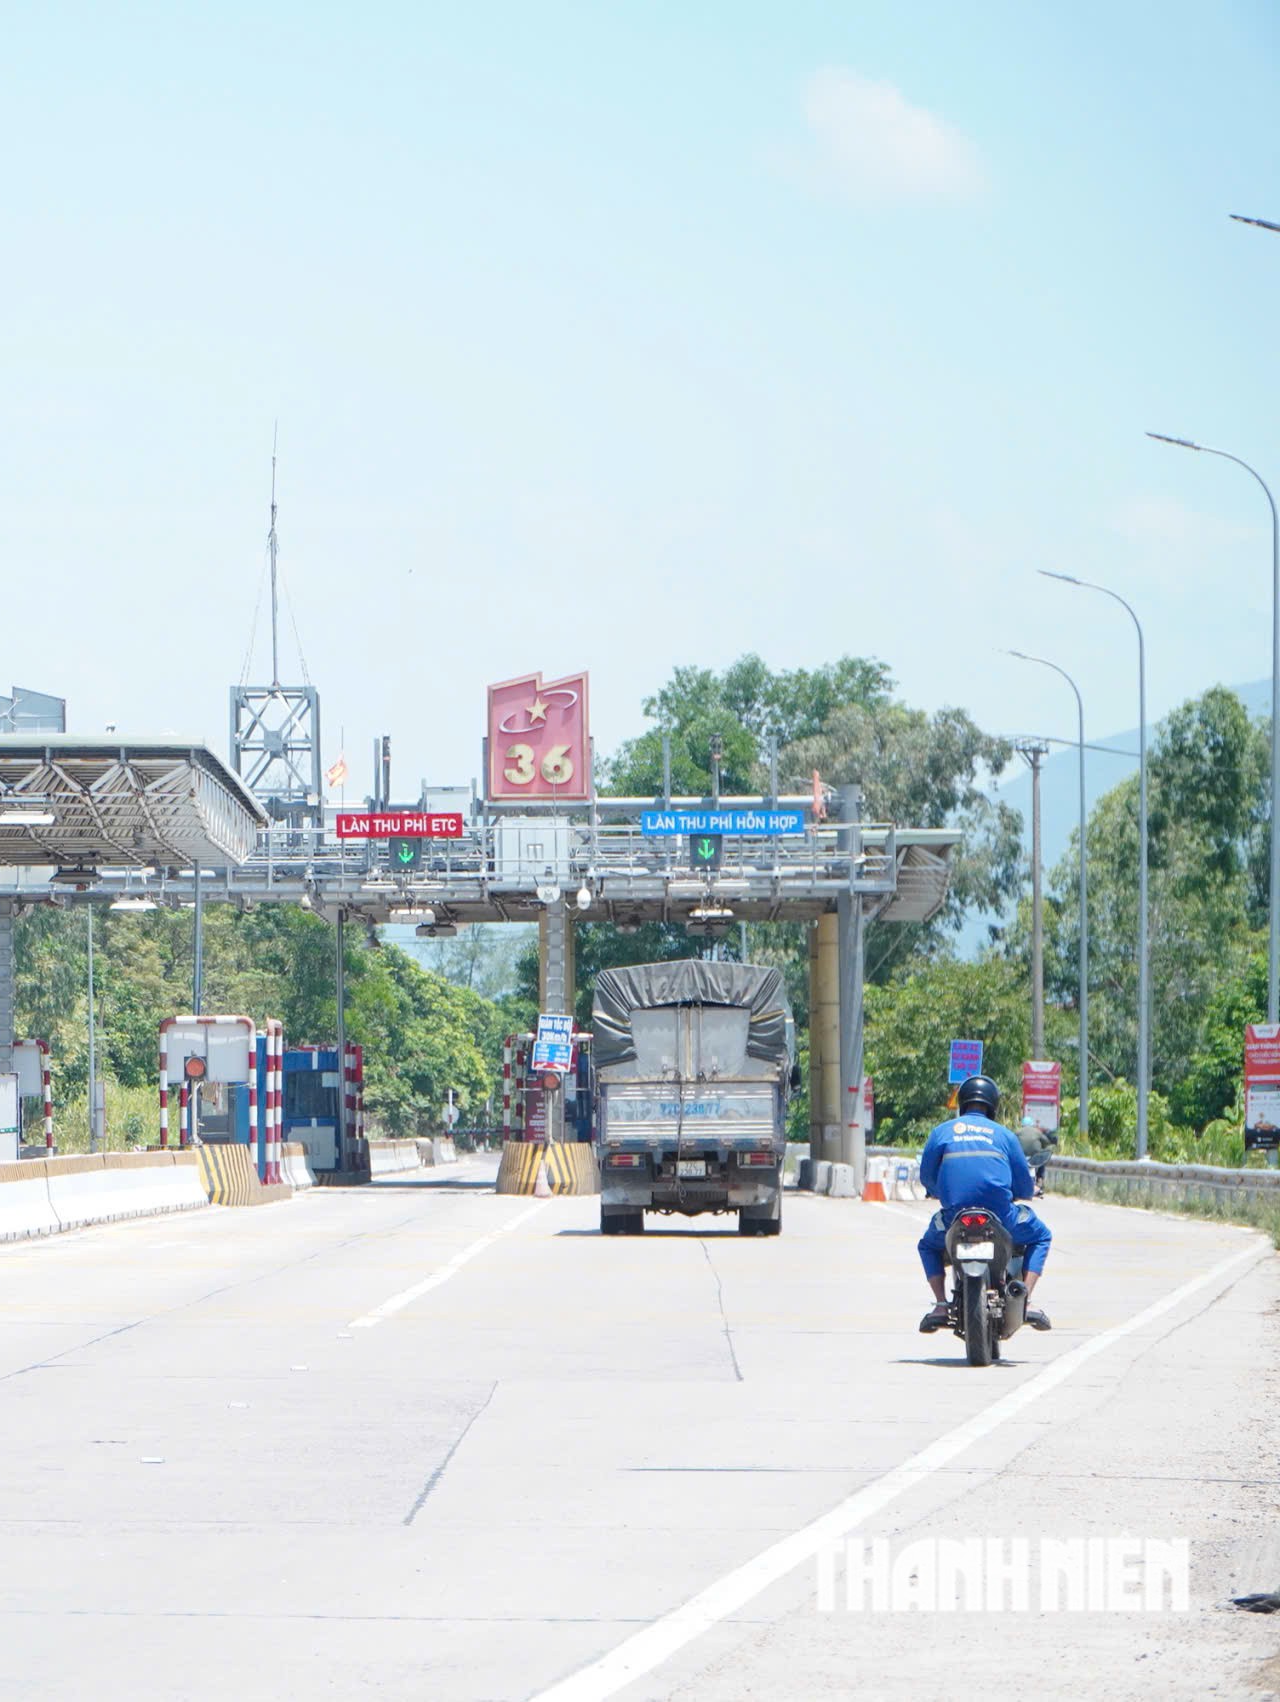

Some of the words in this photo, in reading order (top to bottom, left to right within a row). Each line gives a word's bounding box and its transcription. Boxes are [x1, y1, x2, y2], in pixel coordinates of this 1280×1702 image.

[504, 743, 574, 785] 36
[341, 816, 370, 833] LÀN
[372, 819, 401, 833] THU
[404, 815, 428, 833] PHÍ
[431, 818, 457, 832] ETC
[647, 812, 676, 830] LÀN
[678, 815, 707, 830] THU
[710, 812, 733, 830] PHÍ
[769, 815, 798, 832] HỢP
